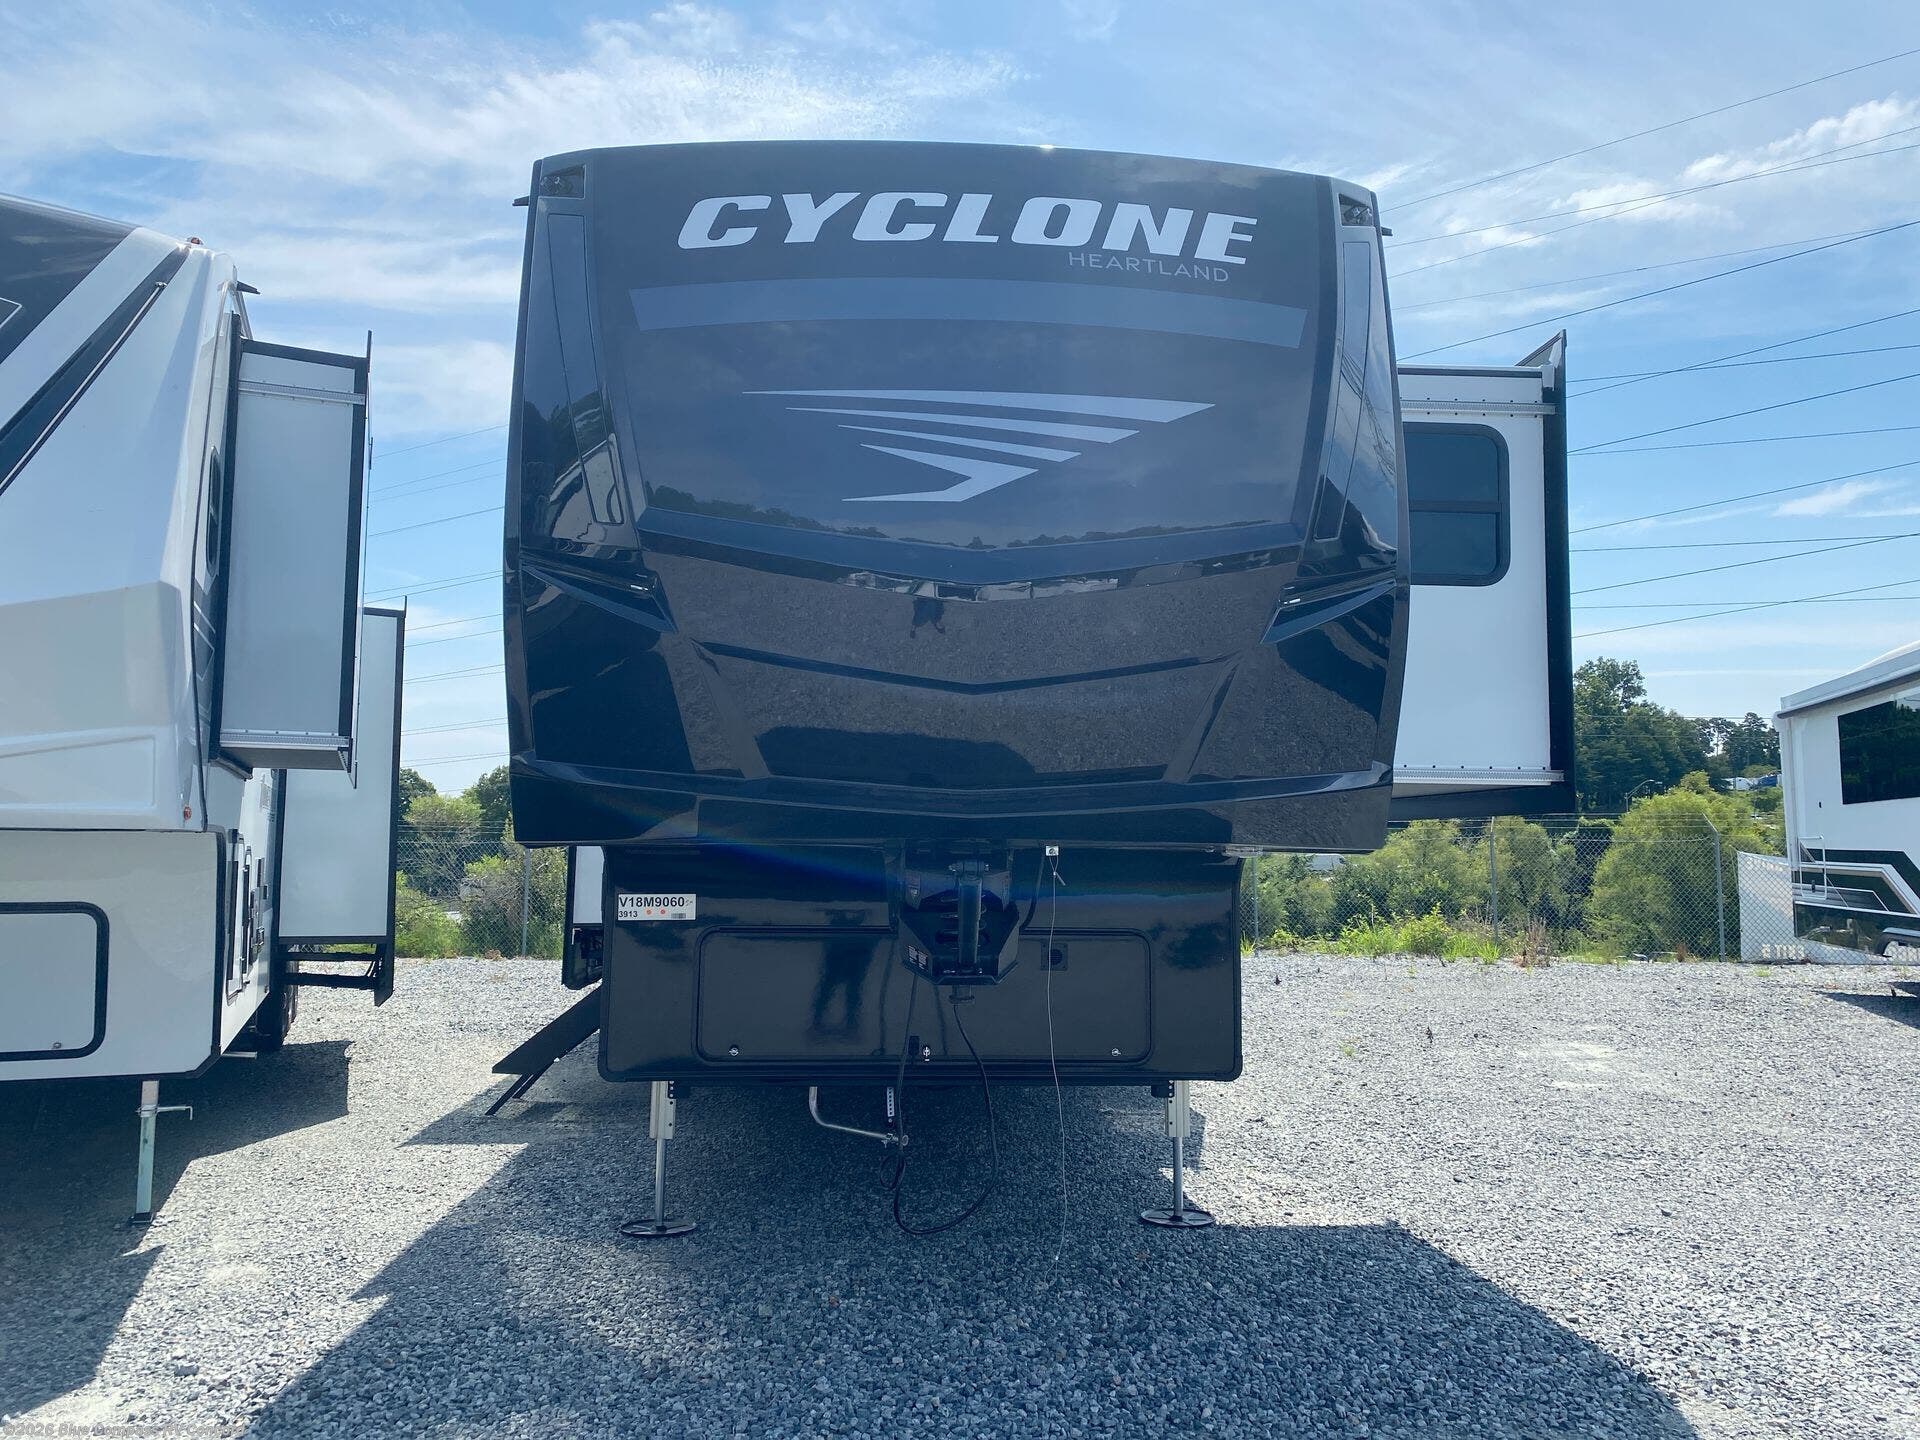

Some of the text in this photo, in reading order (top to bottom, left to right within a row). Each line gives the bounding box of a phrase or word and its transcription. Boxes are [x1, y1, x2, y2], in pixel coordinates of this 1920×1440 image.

[677, 192, 1258, 265] CYCLONE
[1068, 251, 1229, 283] HEARTLAND
[619, 896, 685, 908] V18M9060
[618, 910, 638, 918] 3913
